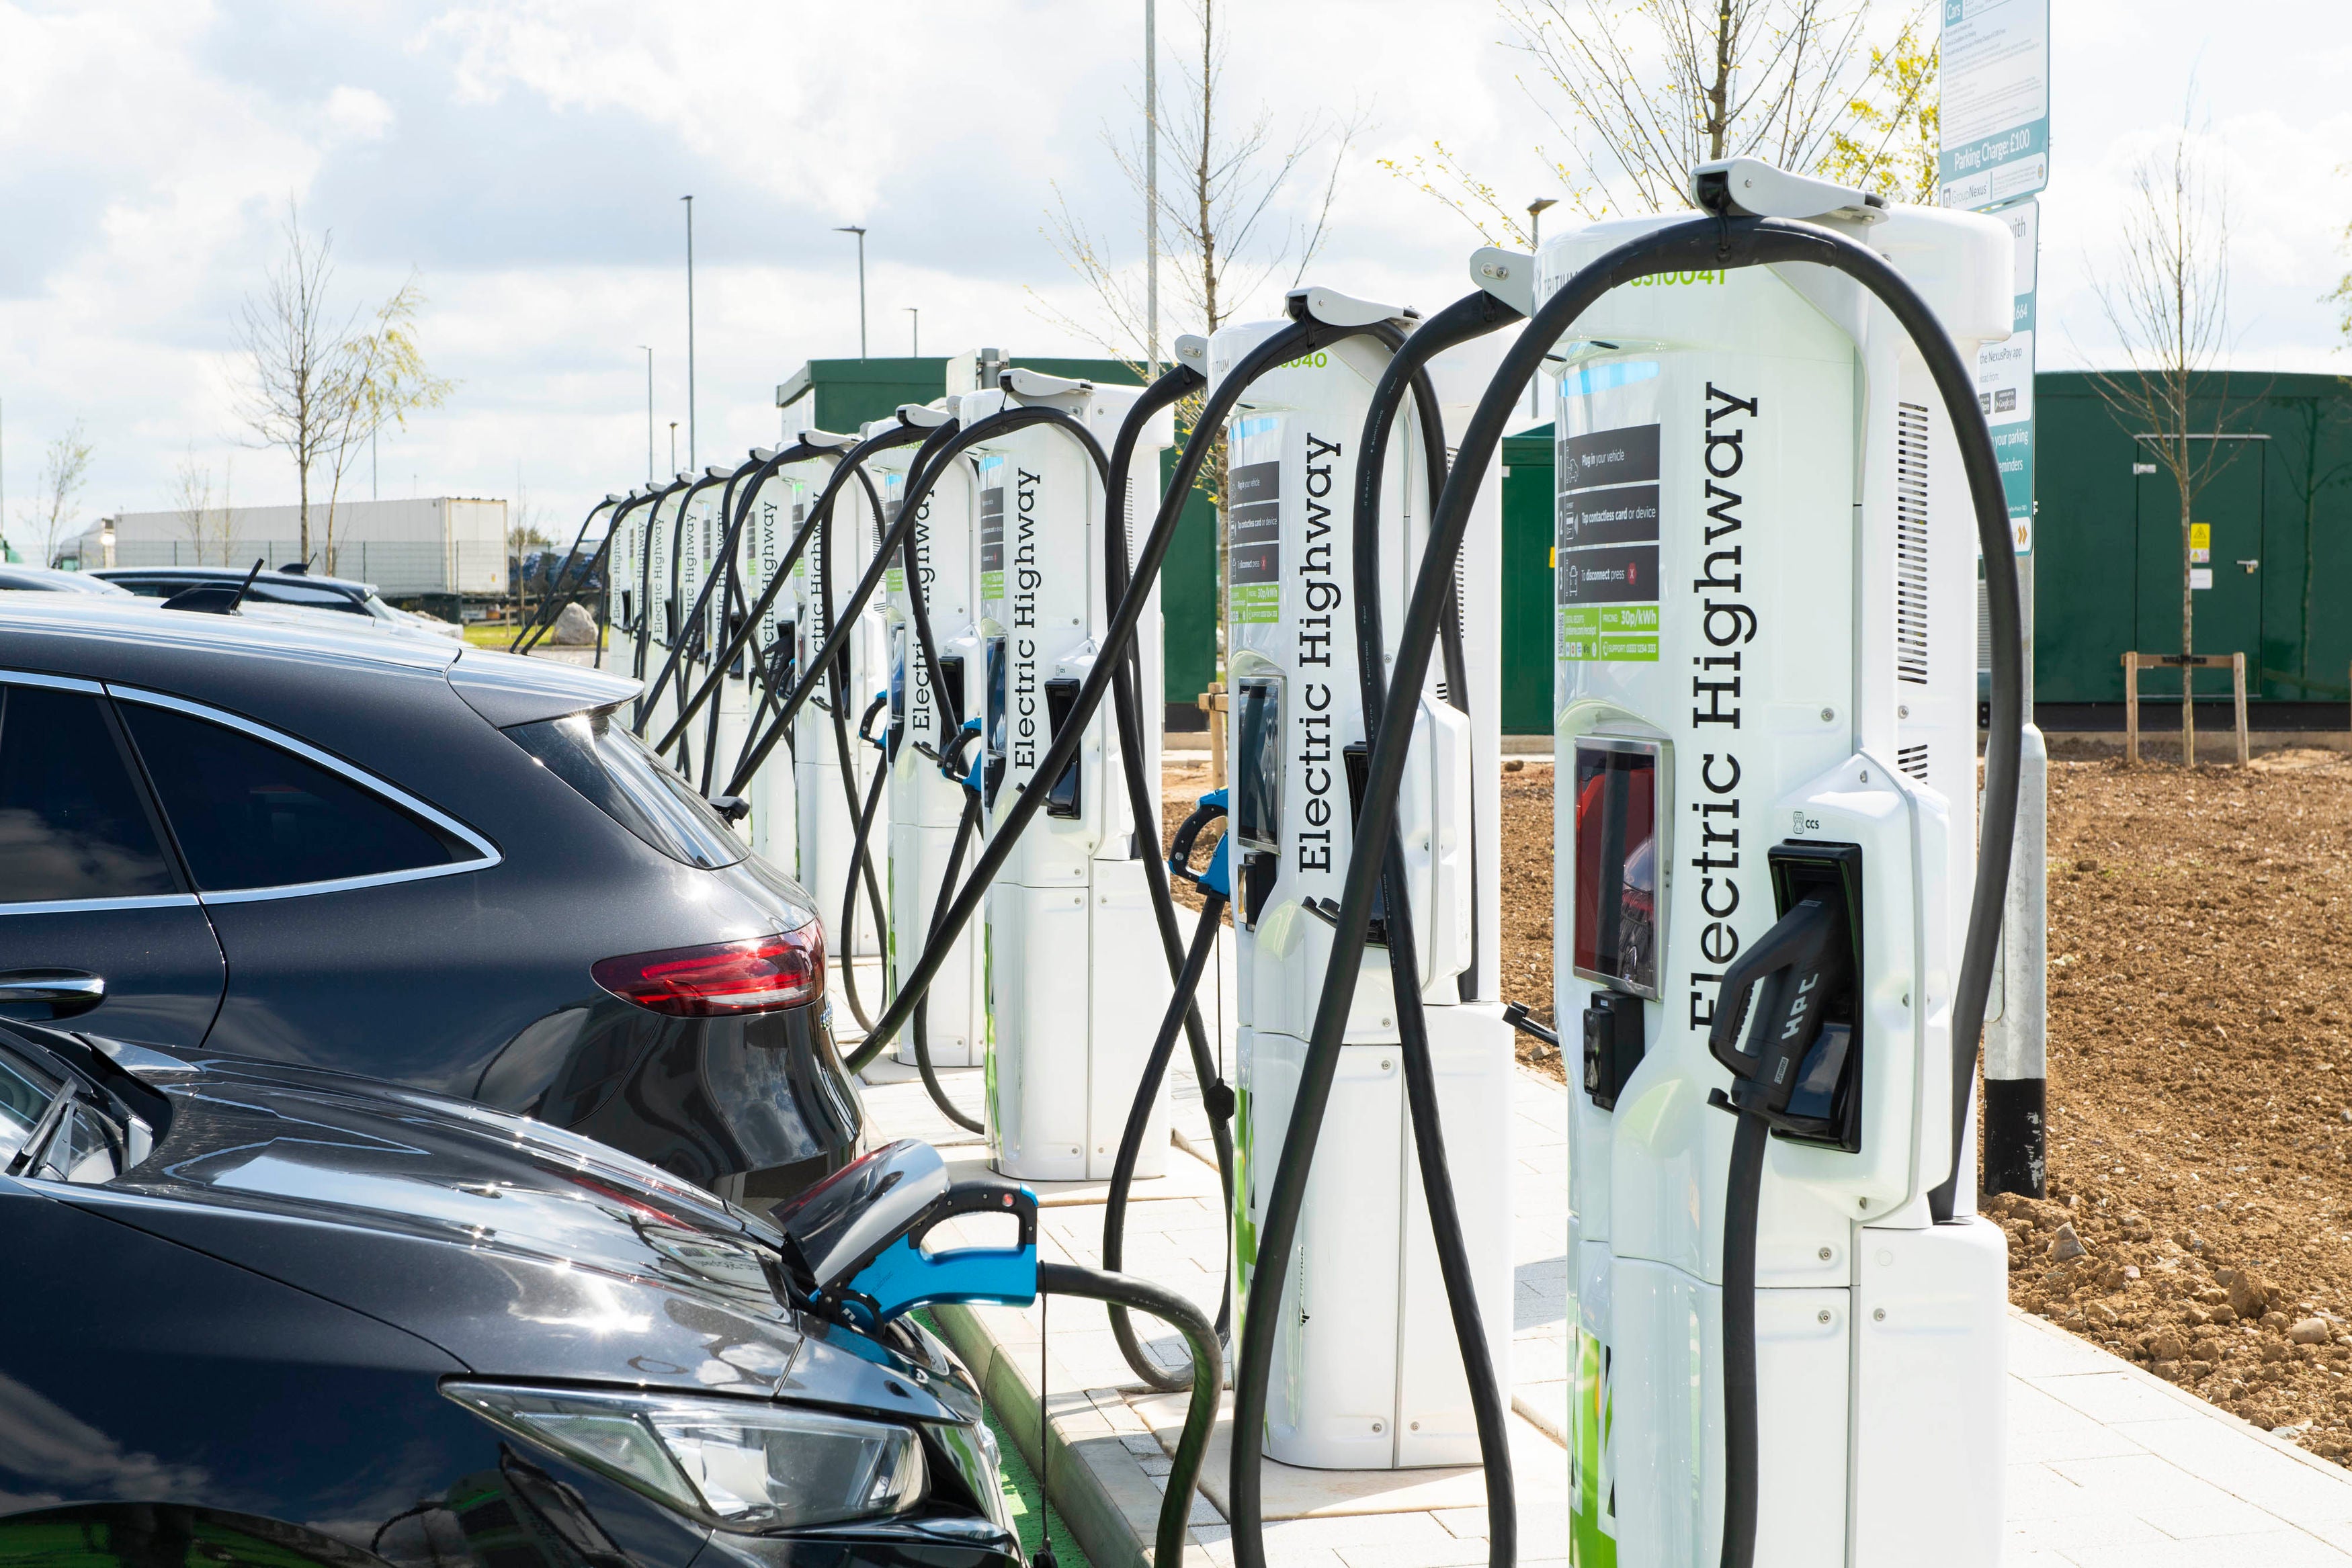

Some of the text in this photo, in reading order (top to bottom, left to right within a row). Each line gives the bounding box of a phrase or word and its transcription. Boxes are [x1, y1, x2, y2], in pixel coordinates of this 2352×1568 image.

[1947, 4, 1961, 20] Cars
[1954, 128, 2030, 171] Parking Charge: £100
[1951, 183, 1987, 204] GroupNexus
[1544, 270, 1579, 297] TRITIU
[2013, 304, 2027, 320] 664
[1980, 347, 2022, 364] the NexusPay app
[1372, 409, 1384, 446] SUMITOMO
[1994, 429, 2029, 449] your parking
[1591, 452, 1596, 464] in
[1595, 453, 1607, 467] your
[1607, 448, 1625, 462] vehicle
[1999, 458, 2023, 473] eminders
[1589, 509, 1614, 523] contactless
[1615, 507, 1628, 521] card
[1628, 510, 1635, 520] or
[1636, 505, 1656, 519] device
[637, 522, 646, 578] Highway
[685, 513, 697, 583] Highway
[716, 511, 726, 589] Hhway
[1692, 382, 1758, 730] Highway
[654, 518, 664, 634] Electric Highway
[762, 501, 778, 671] lectric Highway
[811, 491, 825, 688] Ectric Highwy
[1586, 568, 1610, 581] disconnect
[1611, 569, 1625, 584] press
[913, 490, 935, 731] Electri ghwa
[1014, 467, 1042, 770] Electric Highway
[1620, 609, 1656, 627] 30p/kWh
[1299, 432, 1341, 874] Electric Highway
[1805, 819, 1820, 830] CCS
[1781, 973, 1819, 1040] HPC
